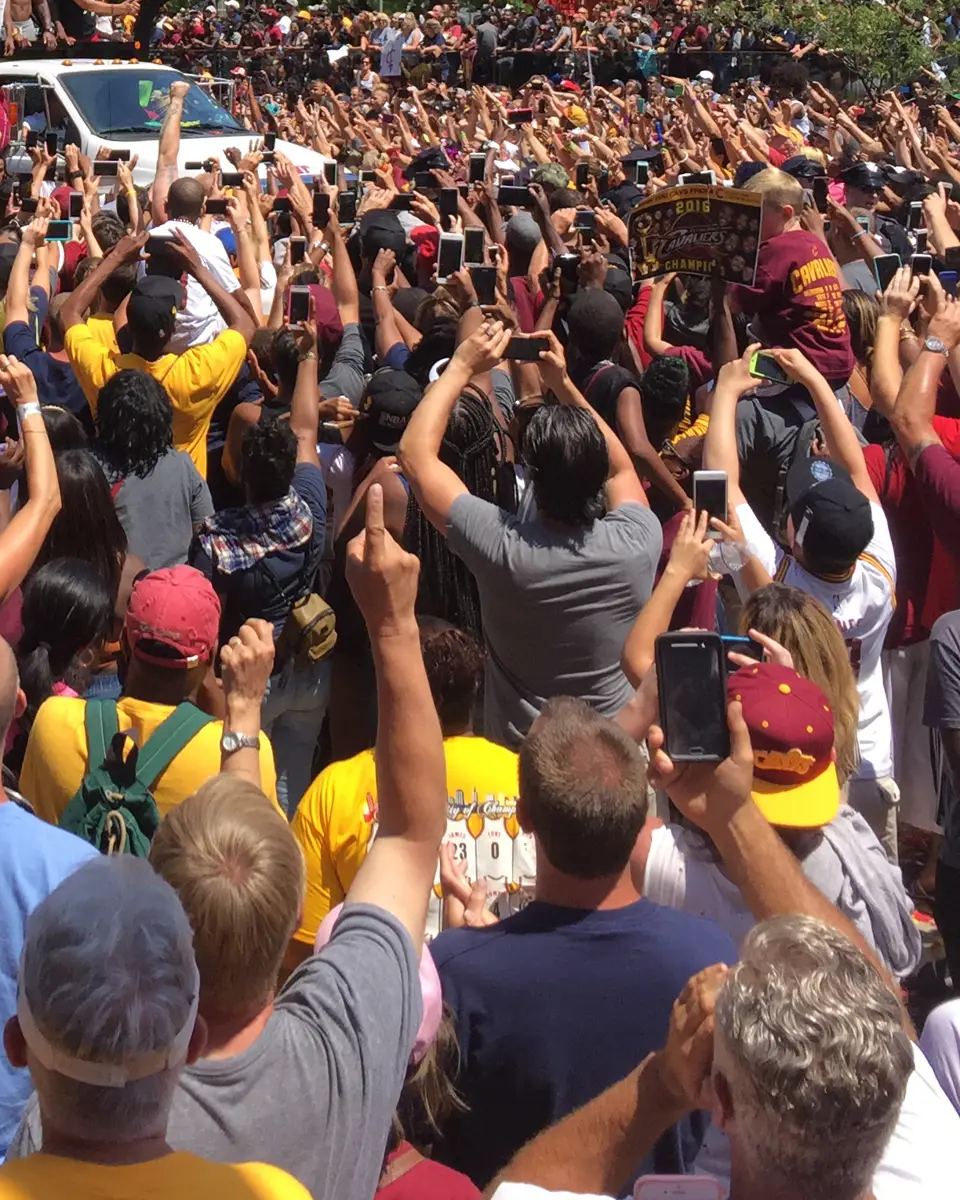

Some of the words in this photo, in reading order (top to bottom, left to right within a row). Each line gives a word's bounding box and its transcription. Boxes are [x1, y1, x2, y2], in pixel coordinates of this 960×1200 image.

[675, 201, 711, 214] 2016
[463, 802, 478, 819] of
[490, 841, 500, 859] 0
